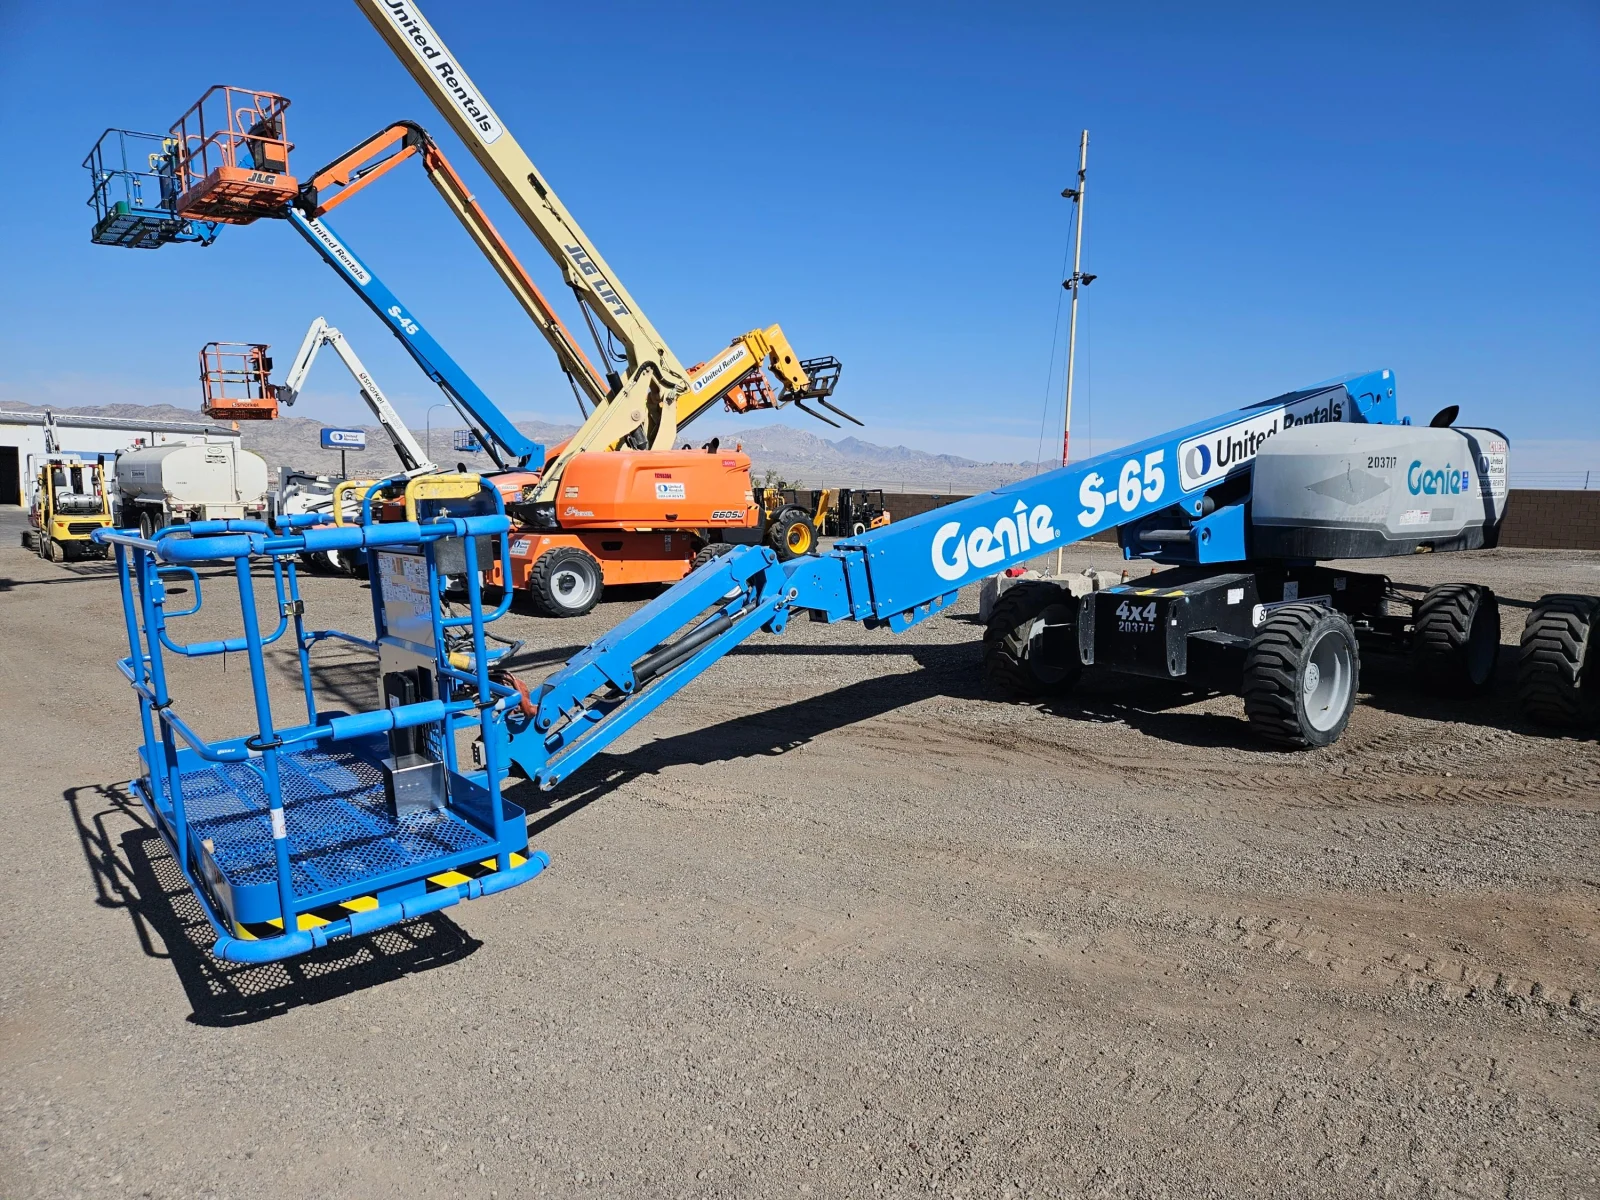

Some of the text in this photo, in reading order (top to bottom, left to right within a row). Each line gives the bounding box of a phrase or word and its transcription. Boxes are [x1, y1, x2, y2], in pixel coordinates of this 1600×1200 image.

[385, 0, 492, 132] United Rentals
[247, 172, 276, 185] JLG
[309, 220, 365, 280] United Rentals
[564, 244, 629, 316] JLG LIFT
[388, 305, 420, 335] S-45
[702, 349, 744, 384] United Rentals
[363, 378, 385, 404] snorkel
[1367, 456, 1397, 468] 203717
[1490, 456, 1503, 465] United
[1490, 465, 1505, 474] Rentals
[1077, 448, 1165, 528] S-65
[1407, 459, 1461, 495] Genie
[712, 511, 744, 519] 660SJ
[931, 499, 1055, 581] Genie
[1116, 600, 1157, 622] 4x4
[1118, 621, 1155, 632] 203717
